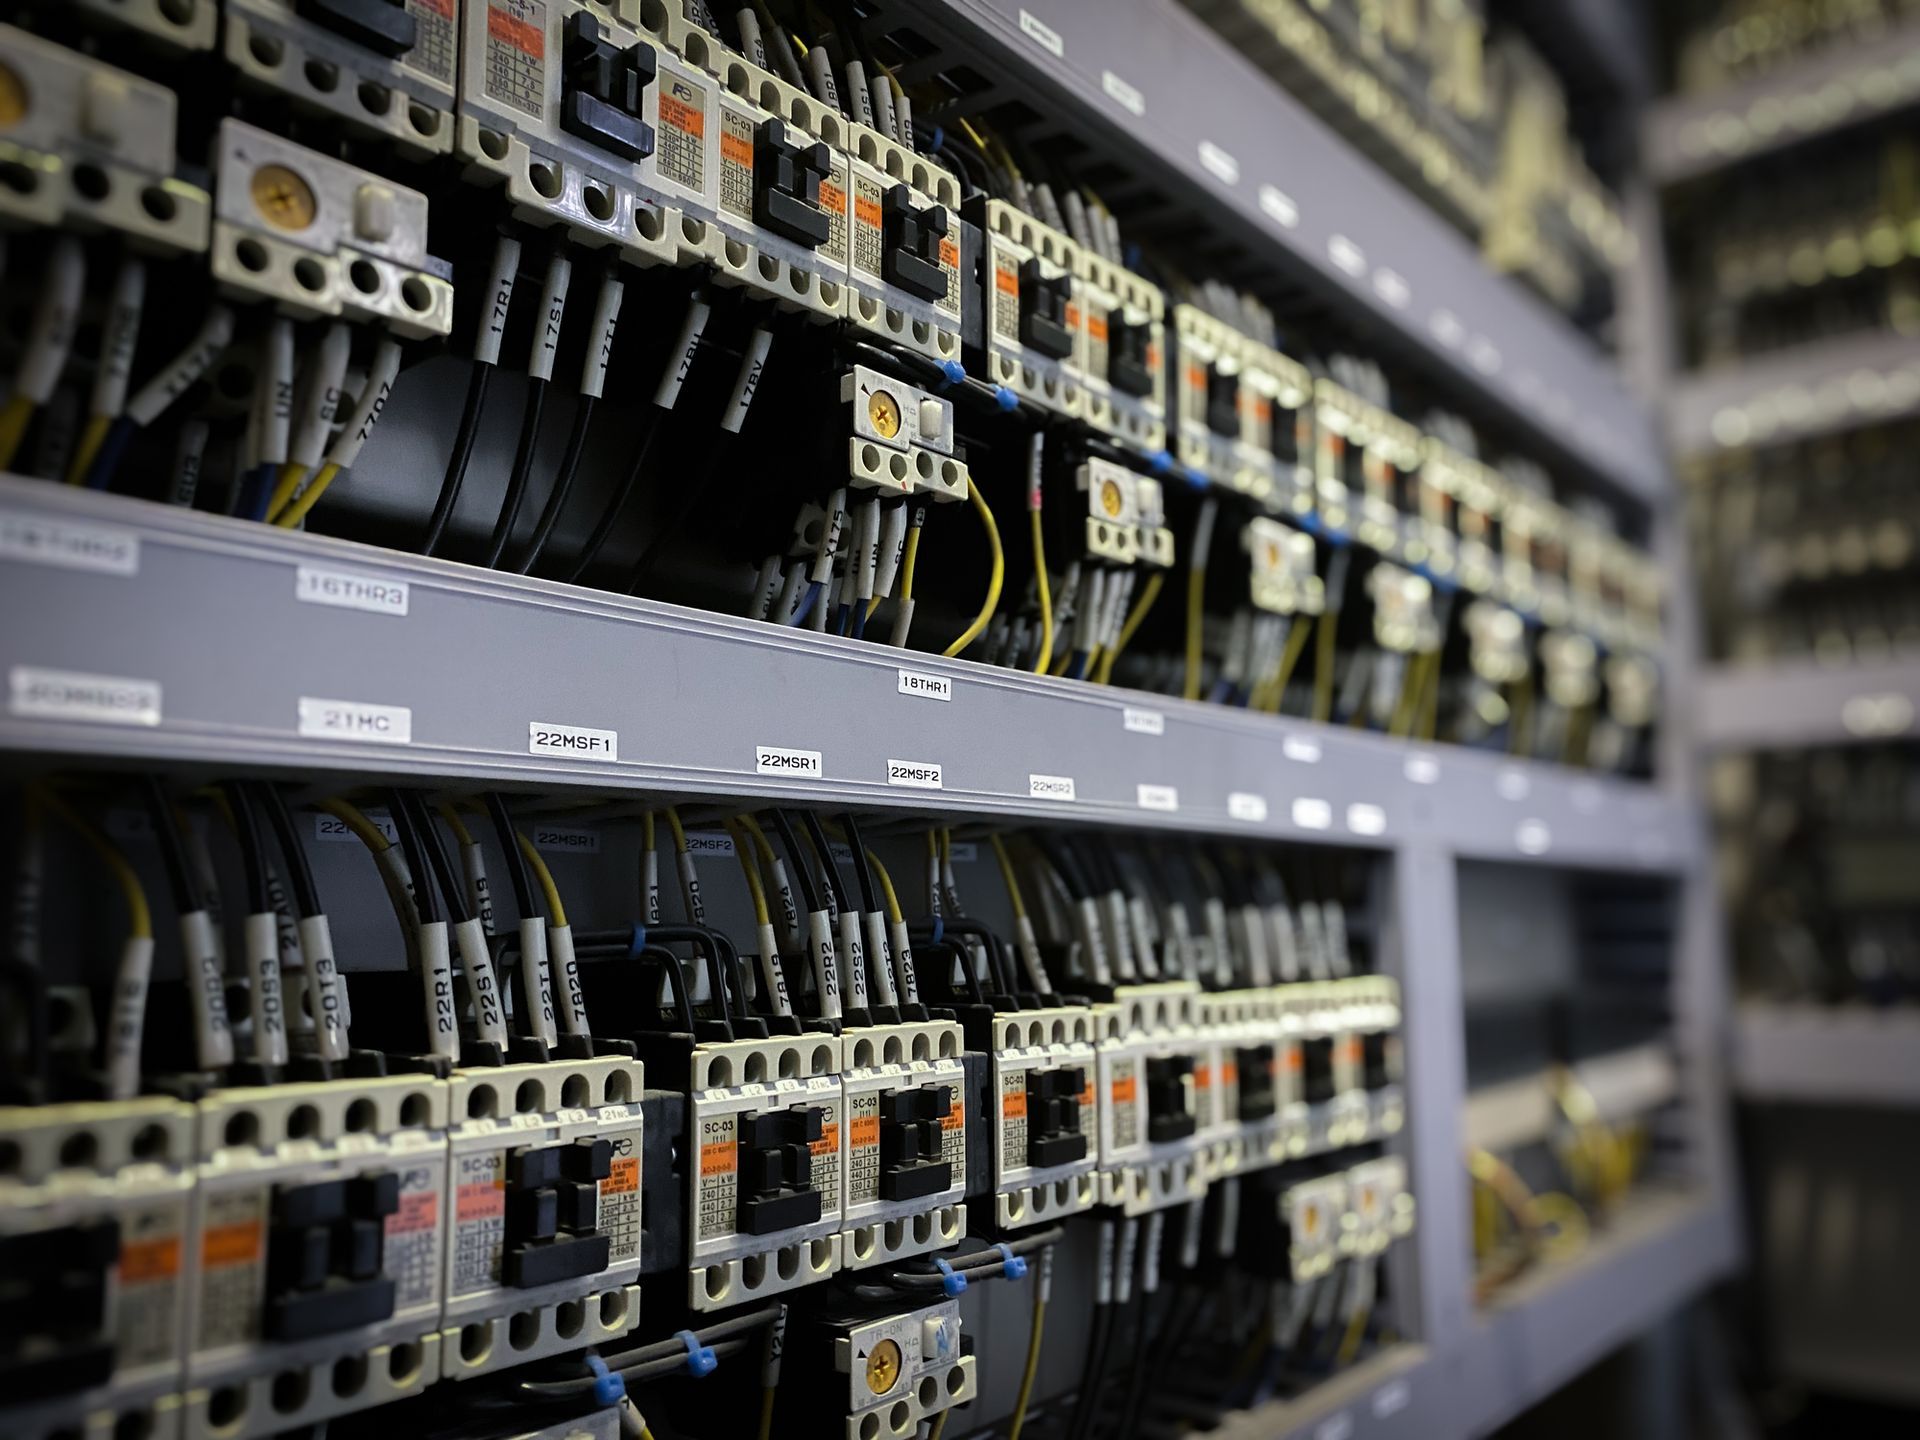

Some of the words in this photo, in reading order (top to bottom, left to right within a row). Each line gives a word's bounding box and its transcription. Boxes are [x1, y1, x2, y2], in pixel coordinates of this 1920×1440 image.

[725, 112, 751, 132] SC-03
[857, 180, 879, 198] SC-03
[491, 279, 513, 333] 17R1
[545, 297, 563, 350] 17S1
[600, 318, 617, 369] 17T1
[826, 510, 843, 559] X175
[904, 678, 947, 694] 18THR1
[536, 732, 610, 752] 22MSF1
[761, 754, 817, 771] 22MSR1
[891, 766, 939, 782] 22MSF2
[1033, 781, 1072, 795] 22MSR2
[538, 832, 595, 848] 22MSR1
[822, 942, 837, 997] 22R2
[852, 942, 865, 995] 22S2
[901, 949, 917, 998] 7823
[316, 959, 342, 1030] 20T3
[434, 967, 452, 1033] 22R1
[473, 963, 498, 1027] 22S1
[566, 961, 585, 1022] 7820
[1004, 1075, 1023, 1086] SC-03
[853, 1097, 877, 1109] SC-03
[704, 1121, 733, 1134] SC-03
[851, 1159, 863, 1169] 240
[867, 1156, 877, 1166] 2.2
[851, 1170, 863, 1179] 440
[867, 1168, 877, 1177] 2.7
[702, 1190, 716, 1200] 240
[721, 1186, 733, 1197] 2.2
[851, 1181, 863, 1191] 550
[867, 1179, 877, 1189] 2.7
[702, 1202, 716, 1211] 440
[721, 1199, 733, 1209] 2.7
[702, 1215, 716, 1225] 550
[721, 1211, 733, 1221] 2.7
